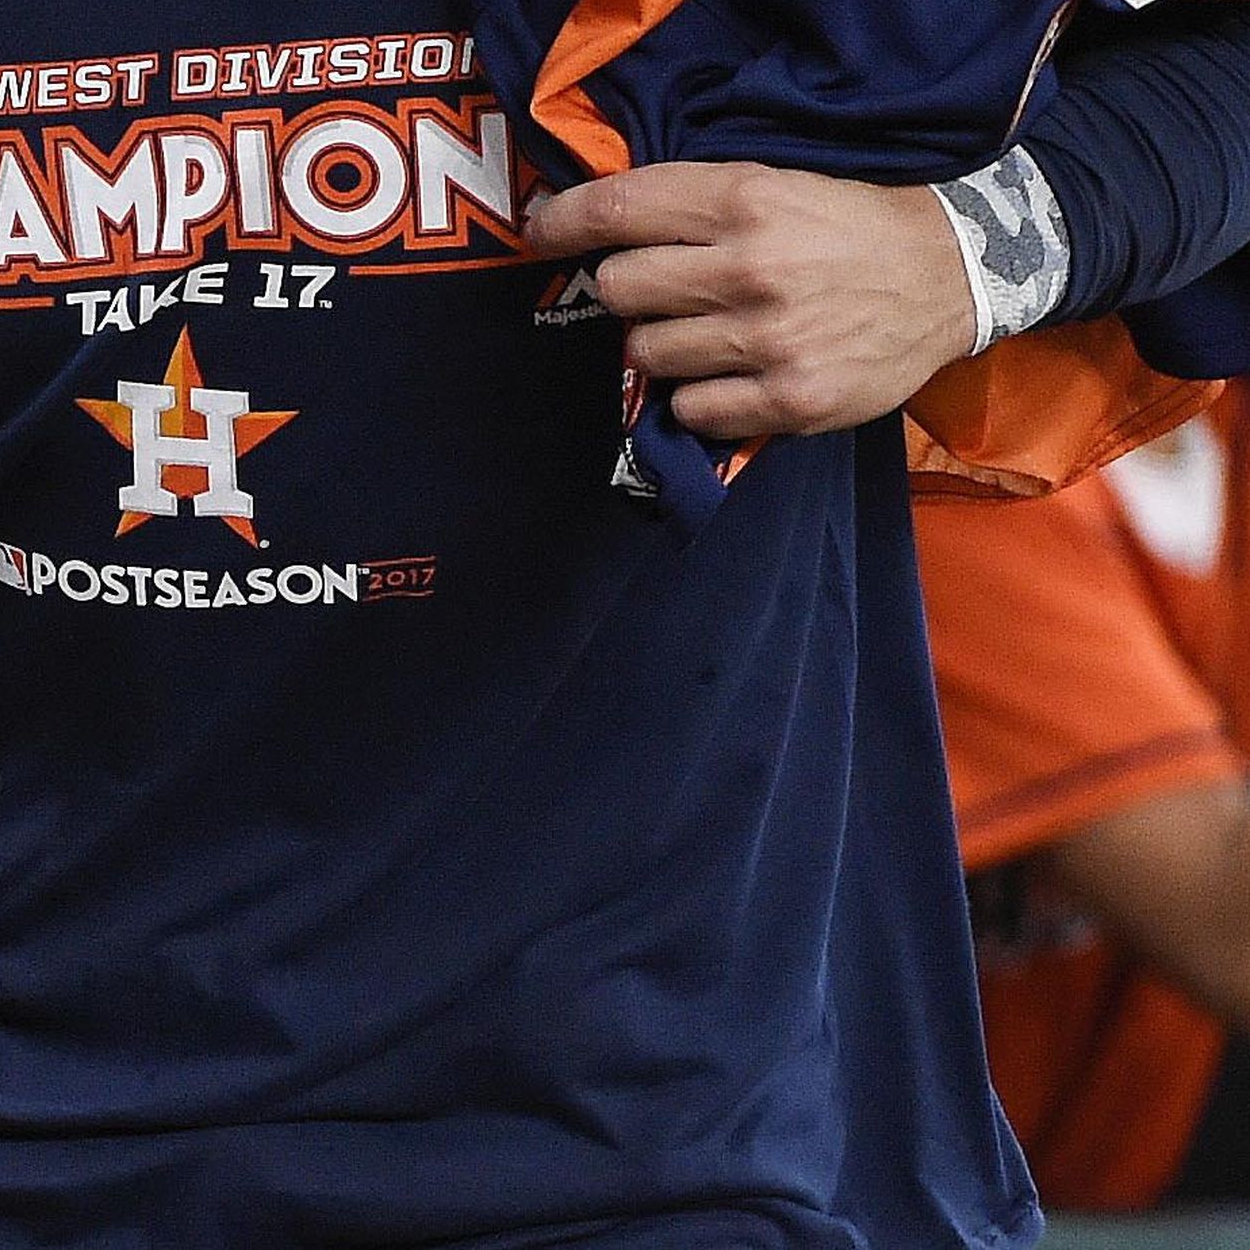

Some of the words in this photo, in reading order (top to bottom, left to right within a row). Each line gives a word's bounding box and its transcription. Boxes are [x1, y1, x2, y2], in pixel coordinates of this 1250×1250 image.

[66, 262, 229, 336] TAKE
[253, 263, 336, 309] 17
[117, 380, 253, 519] H
[32, 552, 358, 608] POSTSEASON
[368, 568, 436, 590] 2017
